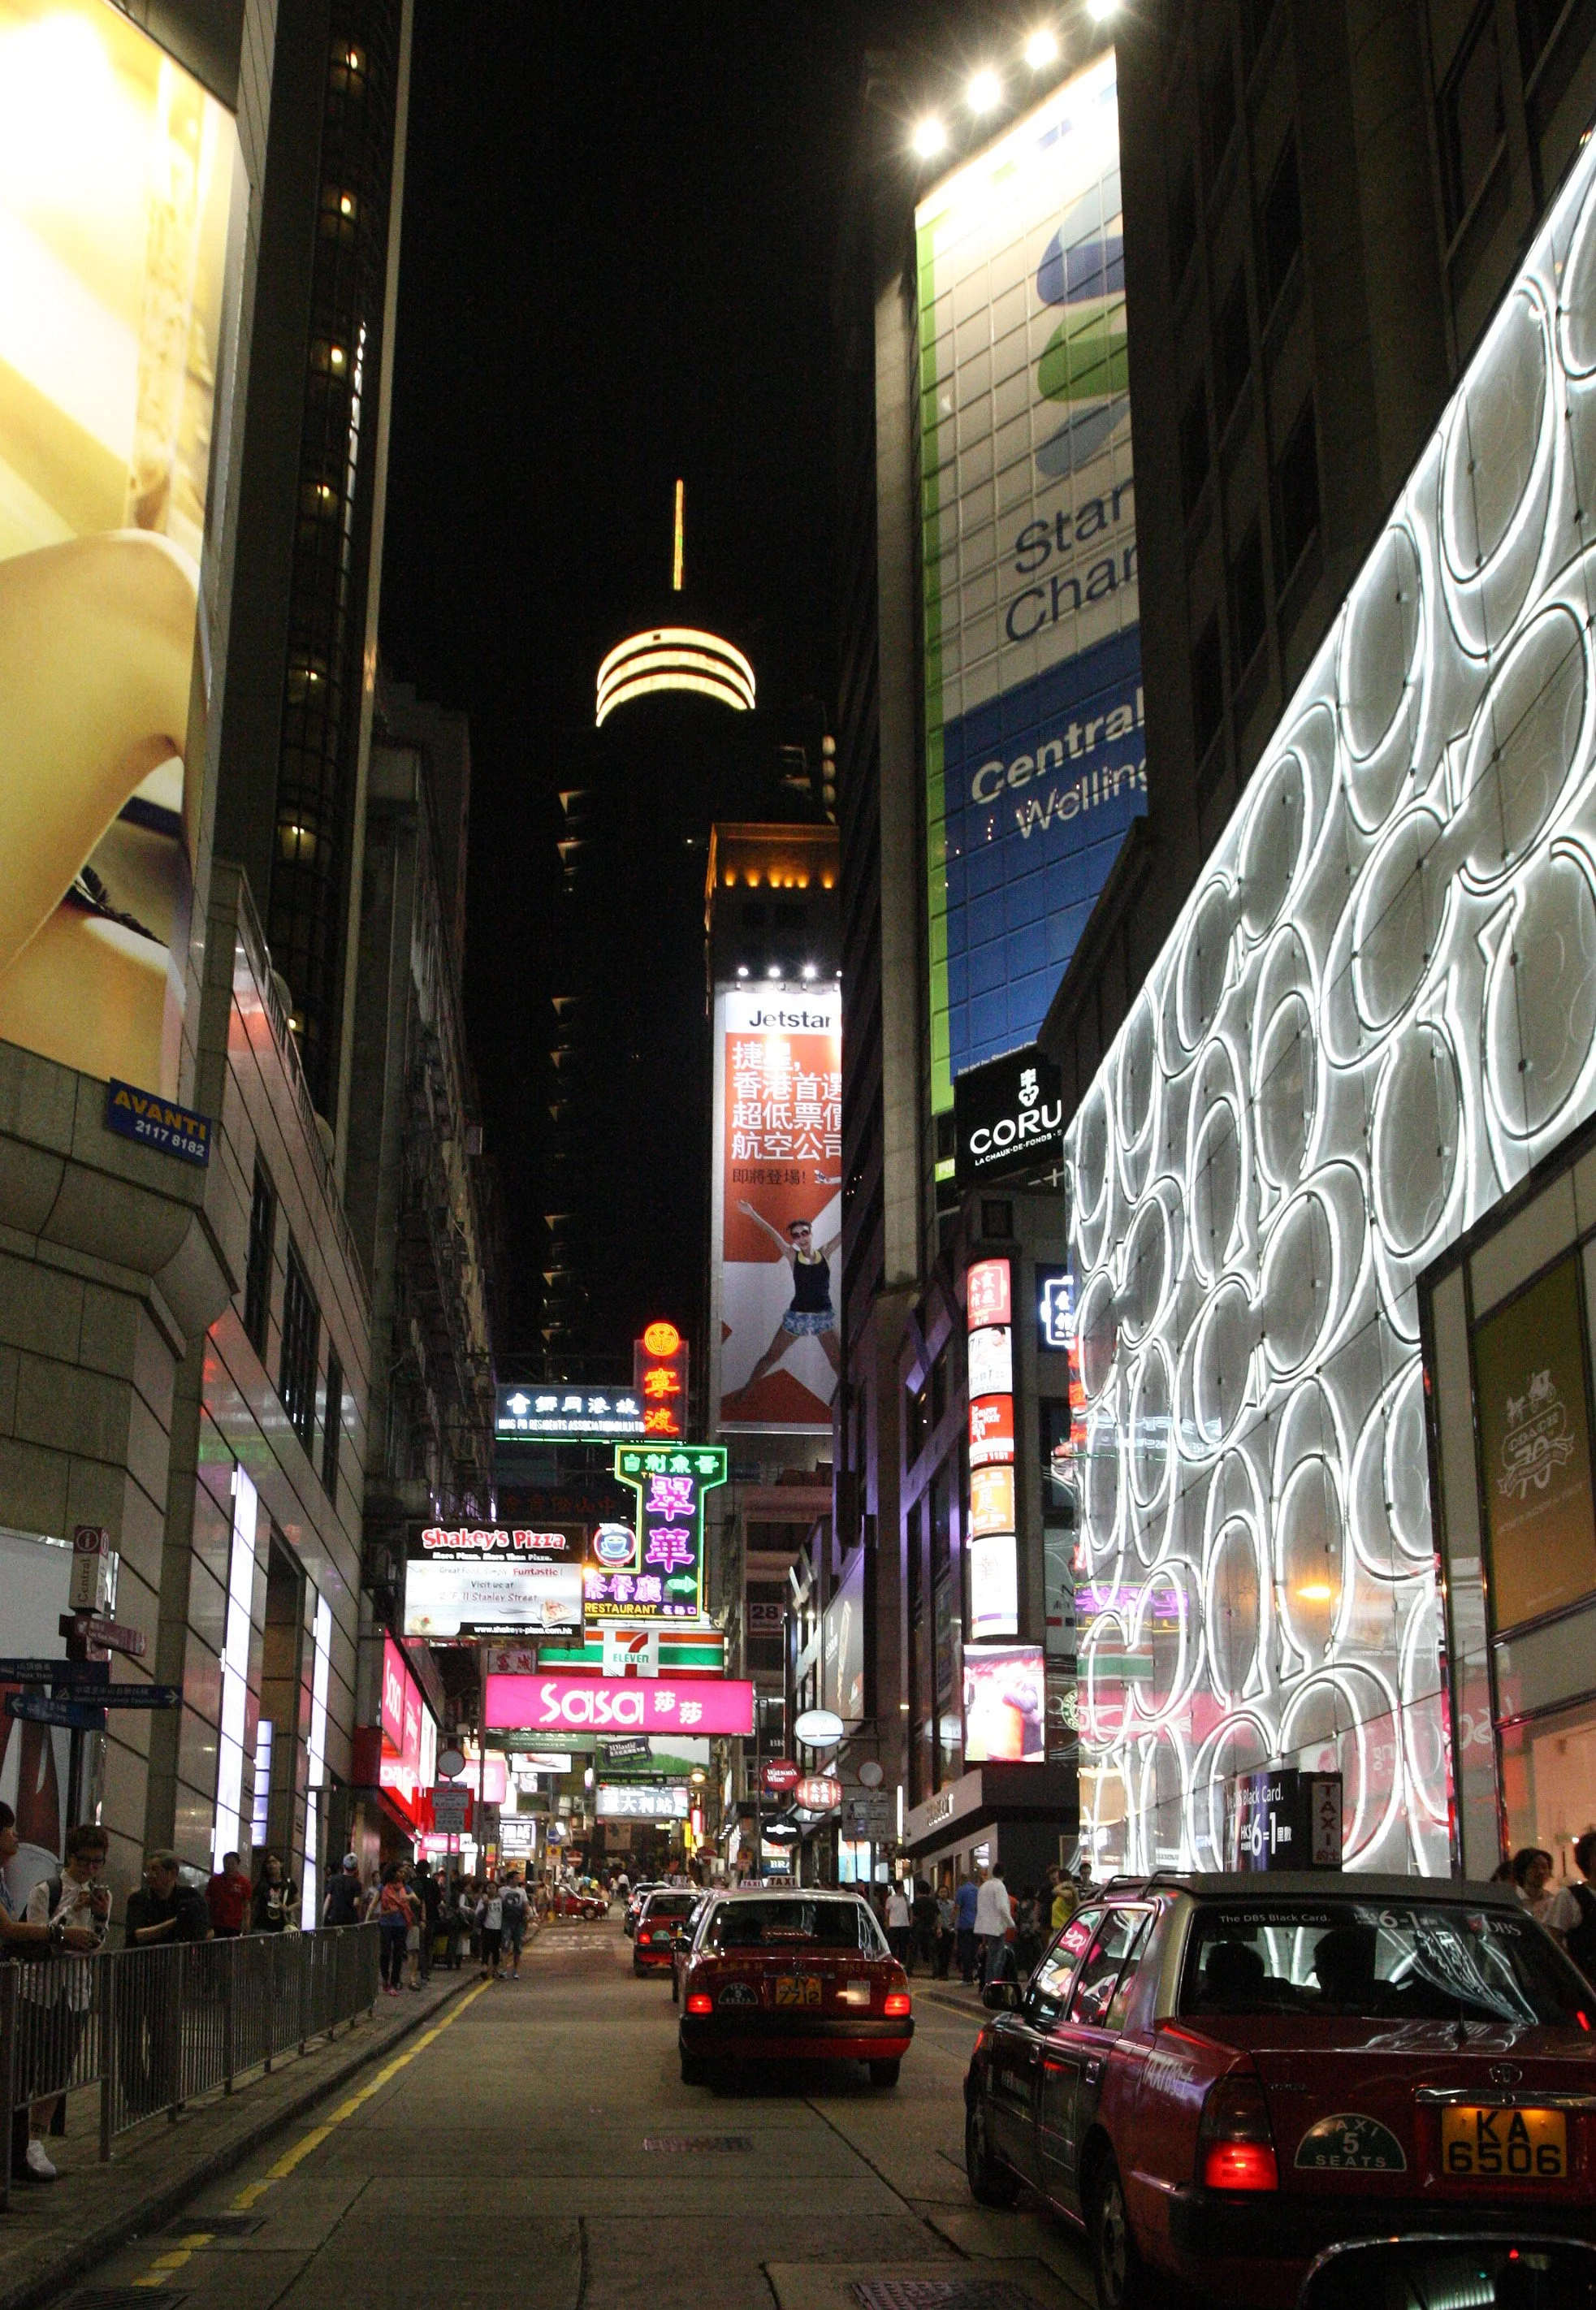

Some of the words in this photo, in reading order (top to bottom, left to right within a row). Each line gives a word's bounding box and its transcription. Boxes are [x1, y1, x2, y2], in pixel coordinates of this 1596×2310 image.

[971, 686, 1144, 804] Central
[749, 1010, 833, 1028] Jetstar
[114, 1090, 206, 1141] AVANTI
[135, 1120, 169, 1141] 2117
[171, 1134, 205, 1157] 8182
[732, 1131, 842, 1161] 航空公司
[975, 1157, 985, 1166] LA
[646, 1475, 696, 1574] 翠華
[422, 1527, 509, 1551] Shakey's
[513, 1530, 567, 1551] Pizza
[78, 1558, 92, 1603] Central
[471, 1581, 491, 1589] Visit
[505, 1581, 515, 1590] at
[472, 1593, 505, 1603] Stanley
[584, 1603, 658, 1615] RESTAURANT
[654, 1690, 703, 1724] 莎莎
[767, 1768, 798, 1777] Watson's
[1261, 1783, 1284, 1803] Card.
[1319, 1784, 1338, 1847] TAXI
[769, 1877, 796, 1886] TAXI
[1220, 1914, 1240, 1923] The
[1243, 1914, 1266, 1923] DBS
[1269, 1913, 1298, 1923] Black
[1301, 1913, 1331, 1923] Card.
[1476, 2110, 1530, 2143] KA
[1342, 2132, 1360, 2154] 5
[1314, 2154, 1387, 2168] SEATS
[1448, 2141, 1561, 2176] 6506
